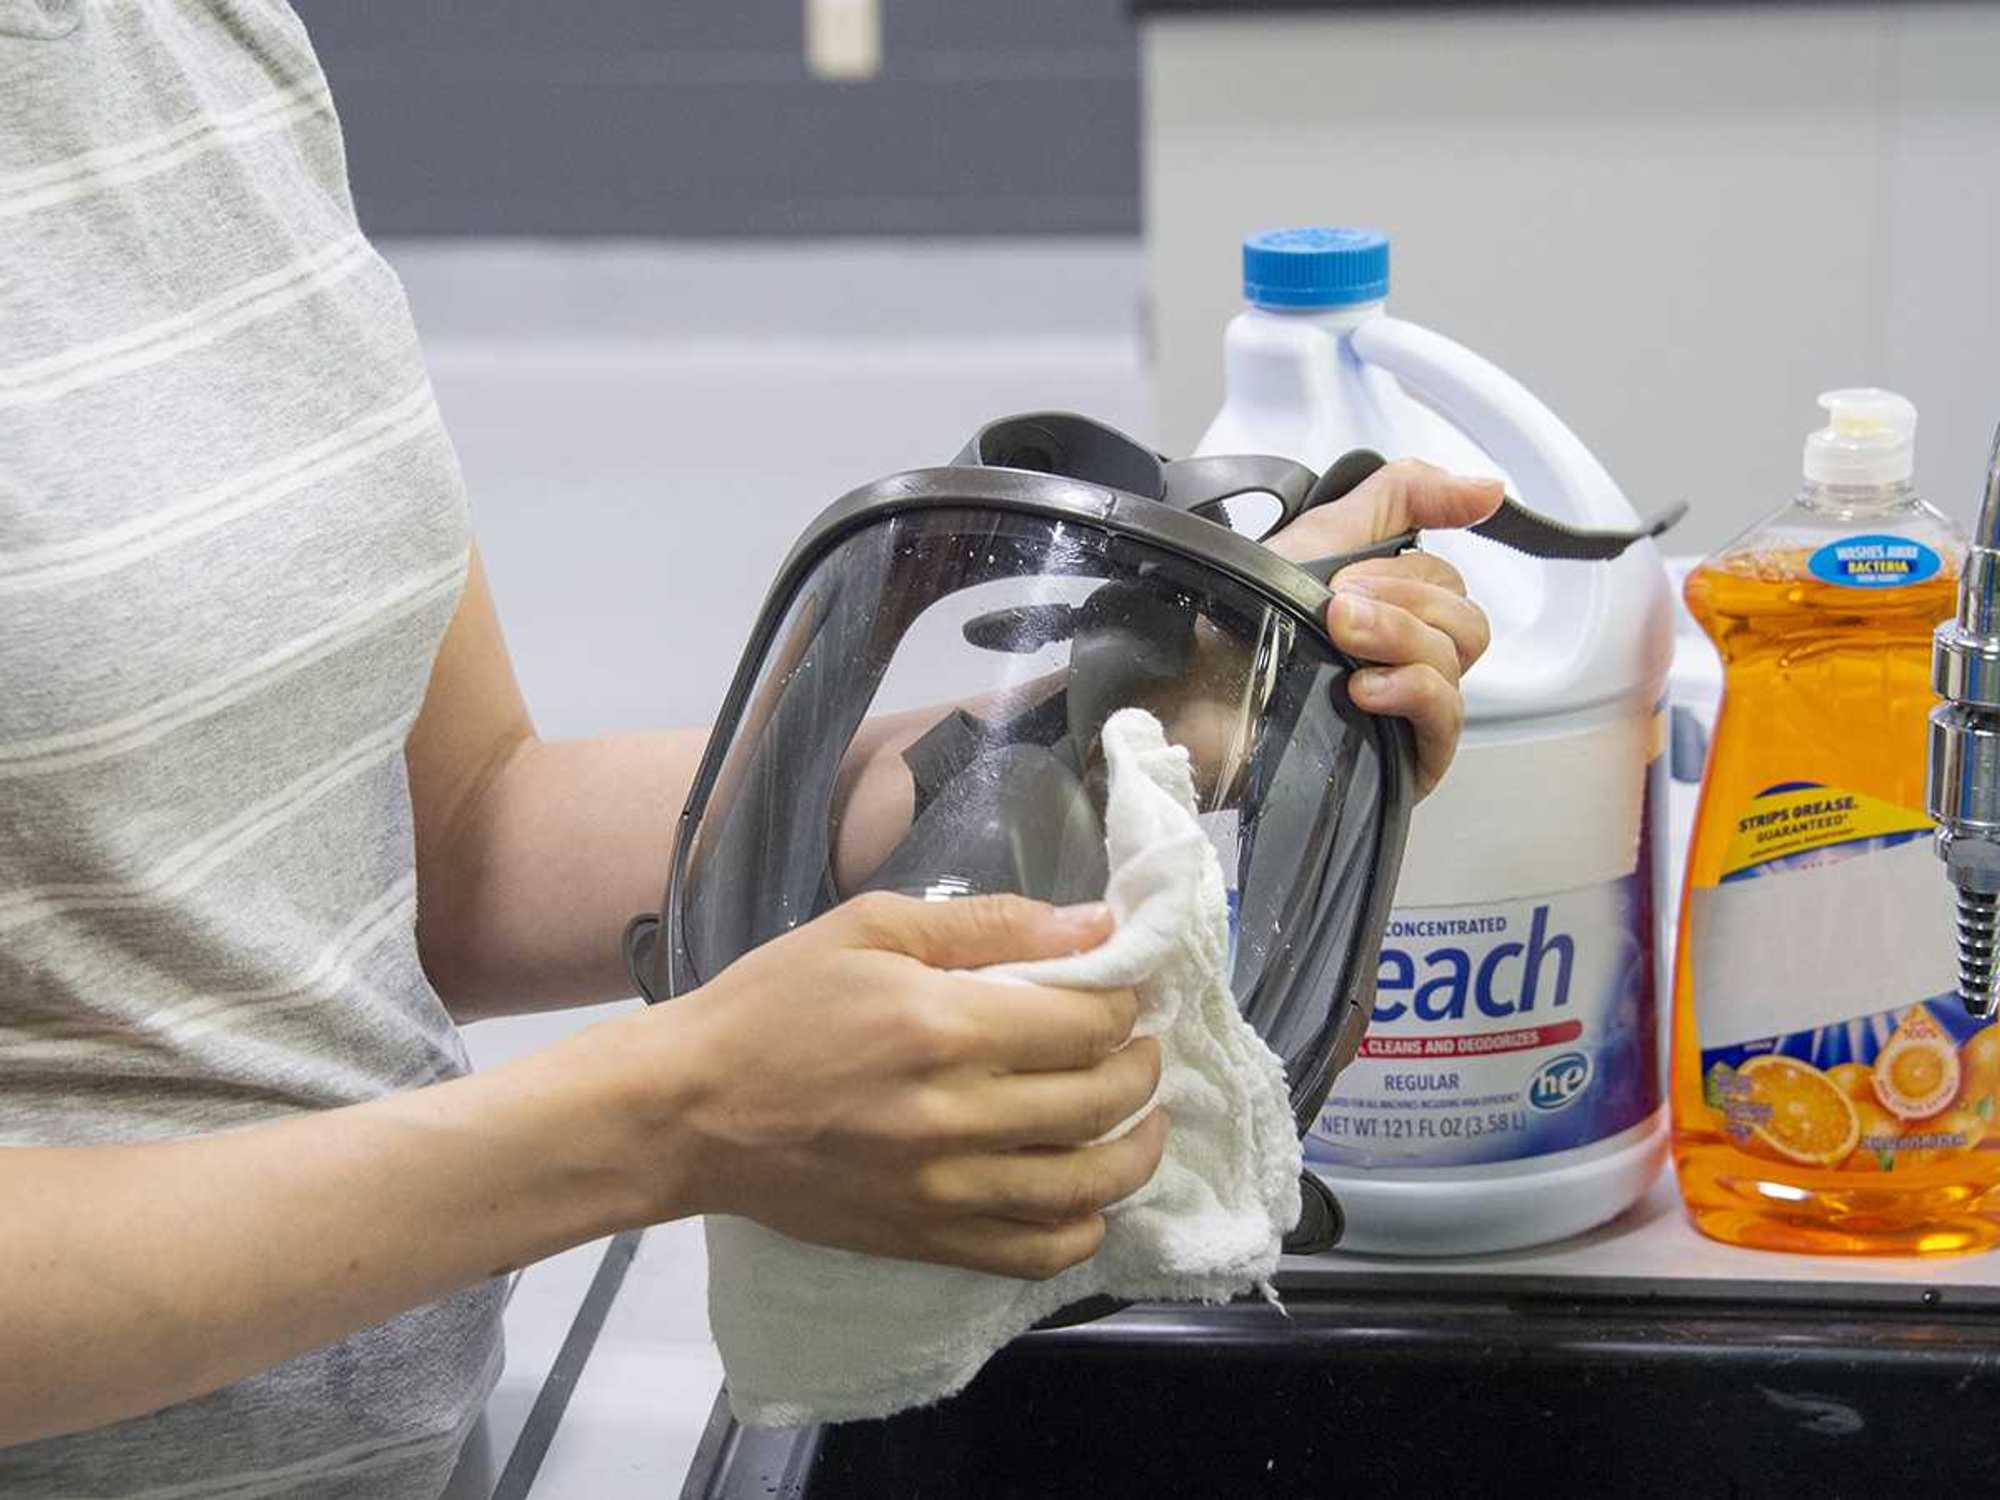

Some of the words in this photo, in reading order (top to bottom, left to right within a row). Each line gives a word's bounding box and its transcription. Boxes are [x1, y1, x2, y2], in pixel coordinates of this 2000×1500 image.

[1847, 560, 1909, 575] BACTERIA
[1738, 808, 1789, 833] STRIPS
[1368, 1039, 1423, 1055] CLEANS
[1425, 1039, 1455, 1054] AND
[1458, 1030, 1541, 1053] DEODORIZES
[1384, 1073, 1460, 1092] REGULAR
[1538, 1066, 1584, 1096] he
[1321, 1115, 1349, 1136] NET
[1384, 1119, 1413, 1138] 121
[1419, 1118, 1438, 1138] FL
[1440, 1116, 1463, 1137] OZ
[1465, 1112, 1509, 1138] (3.58
